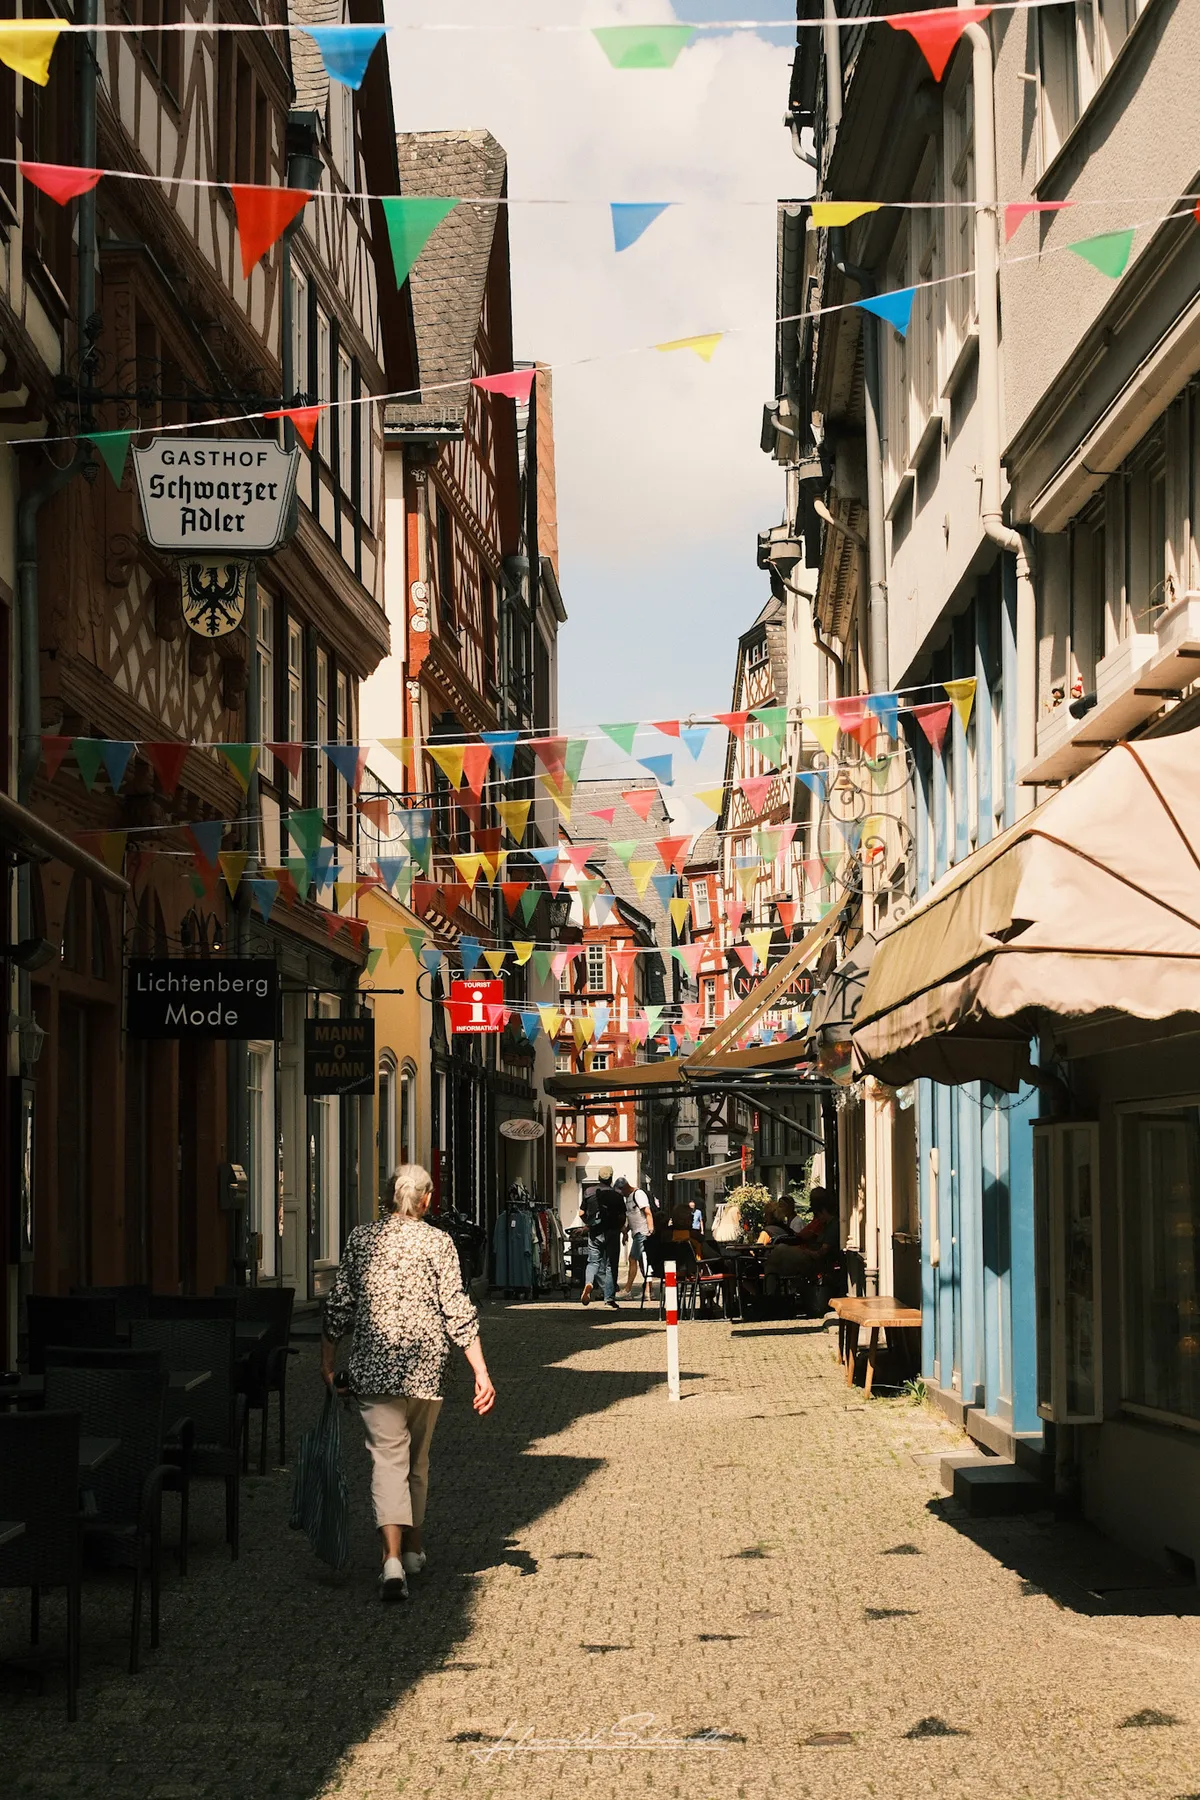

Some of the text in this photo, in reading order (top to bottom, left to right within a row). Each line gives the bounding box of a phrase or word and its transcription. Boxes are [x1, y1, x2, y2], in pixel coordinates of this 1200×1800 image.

[161, 450, 268, 467] GASTHOF
[150, 474, 278, 506] Schwarzer
[180, 506, 246, 536] Adler
[137, 971, 269, 997] Lichtenberg
[165, 1002, 239, 1026] Mode
[315, 1026, 365, 1041] MANN
[315, 1062, 365, 1077] MANN
